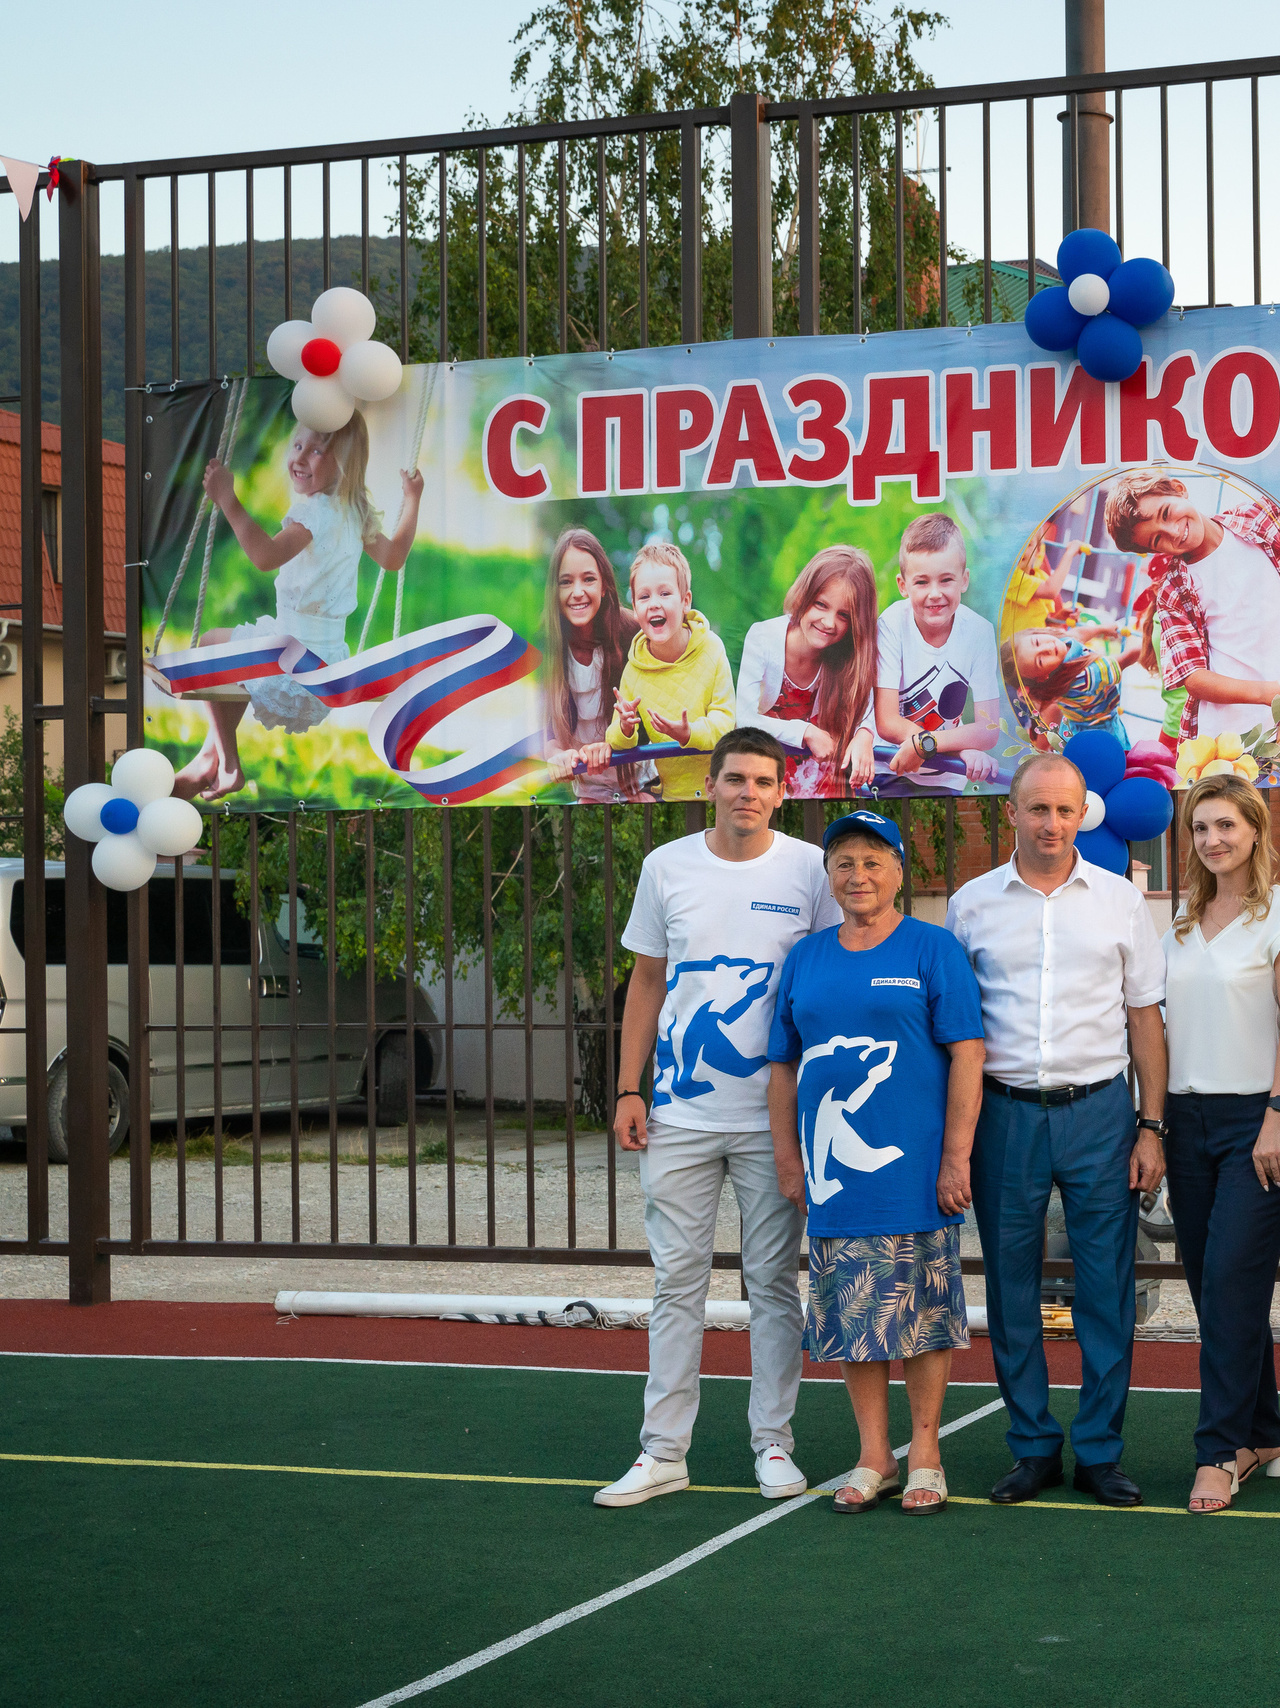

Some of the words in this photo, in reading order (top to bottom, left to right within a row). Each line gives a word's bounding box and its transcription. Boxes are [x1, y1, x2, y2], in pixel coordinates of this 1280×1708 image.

[484, 397, 549, 499] С
[752, 903, 777, 911] ЕДИНАЯ
[776, 905, 800, 915] РОССИЯ
[897, 979, 919, 987] РОССИЯ
